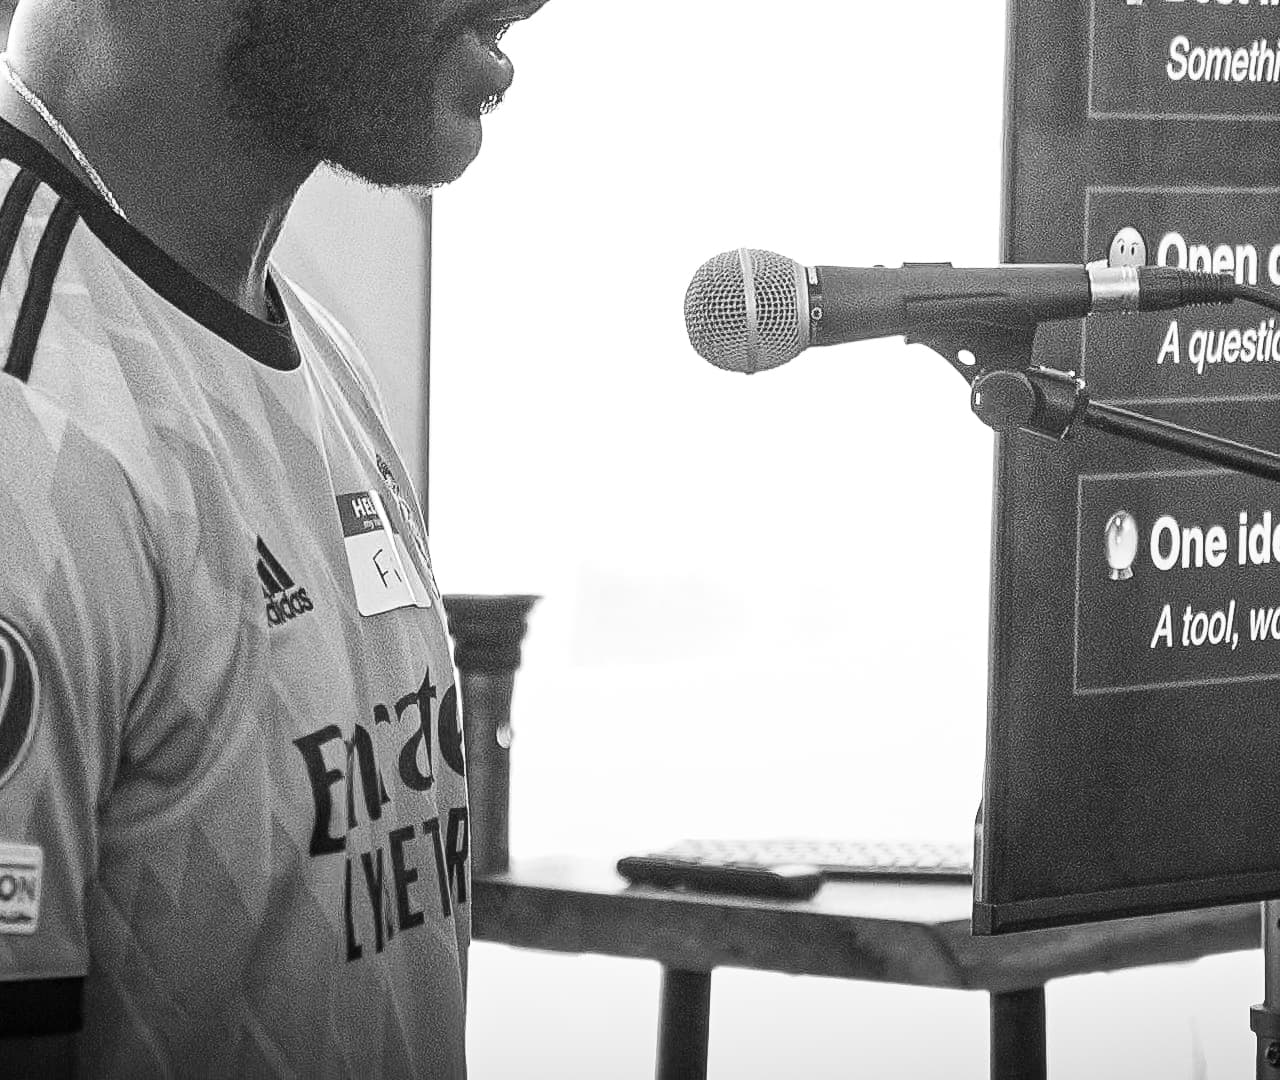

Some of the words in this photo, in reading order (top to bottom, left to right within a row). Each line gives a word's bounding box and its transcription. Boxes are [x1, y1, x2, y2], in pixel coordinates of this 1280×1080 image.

[1157, 320, 1180, 364] A
[1150, 515, 1228, 571] One
[1150, 604, 1173, 649] A
[1182, 599, 1239, 650] tool,
